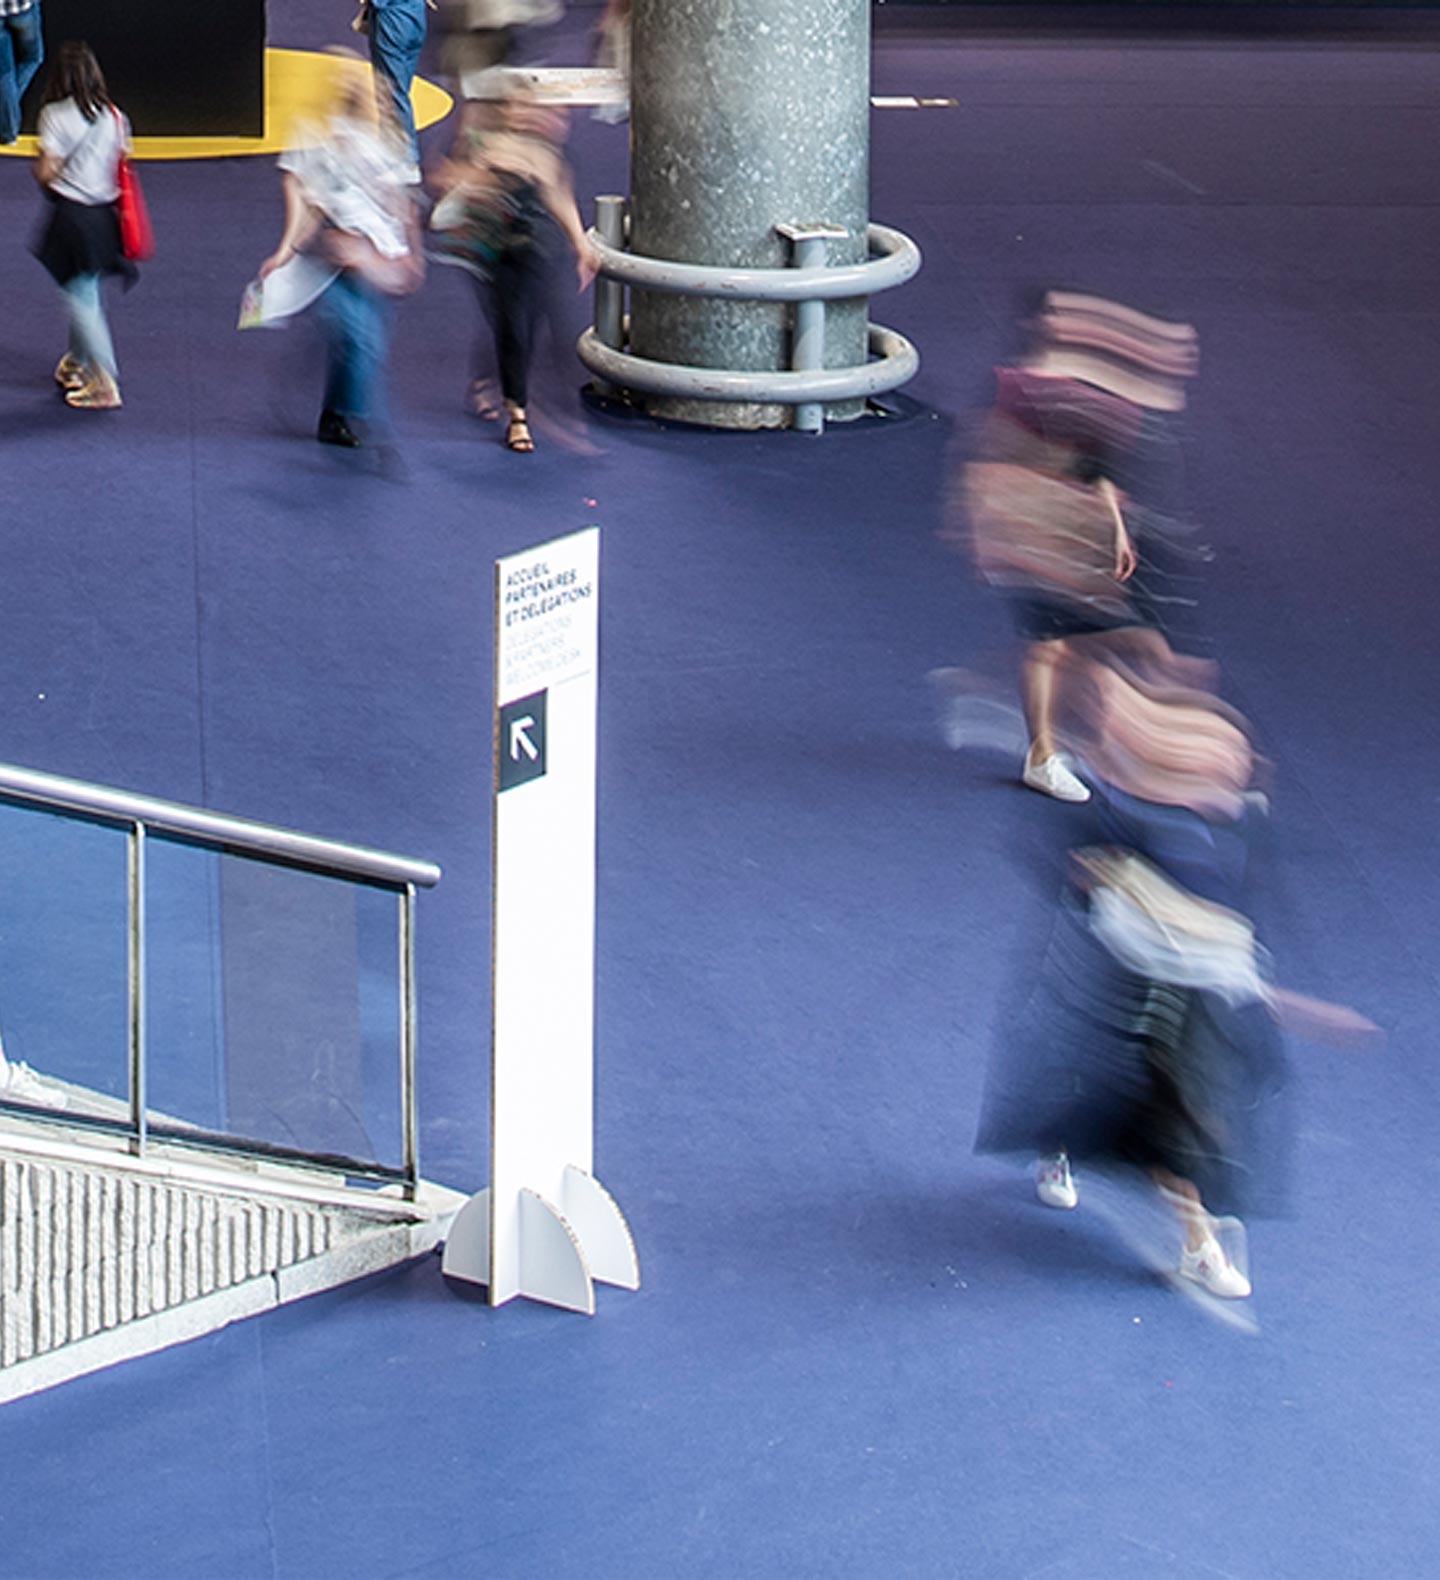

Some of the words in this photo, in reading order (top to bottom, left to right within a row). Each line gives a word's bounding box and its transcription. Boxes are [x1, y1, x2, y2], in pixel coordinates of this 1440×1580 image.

[506, 562, 550, 586] ACCUEIL
[505, 568, 577, 605] PARTENAIRES
[505, 609, 519, 628] ET
